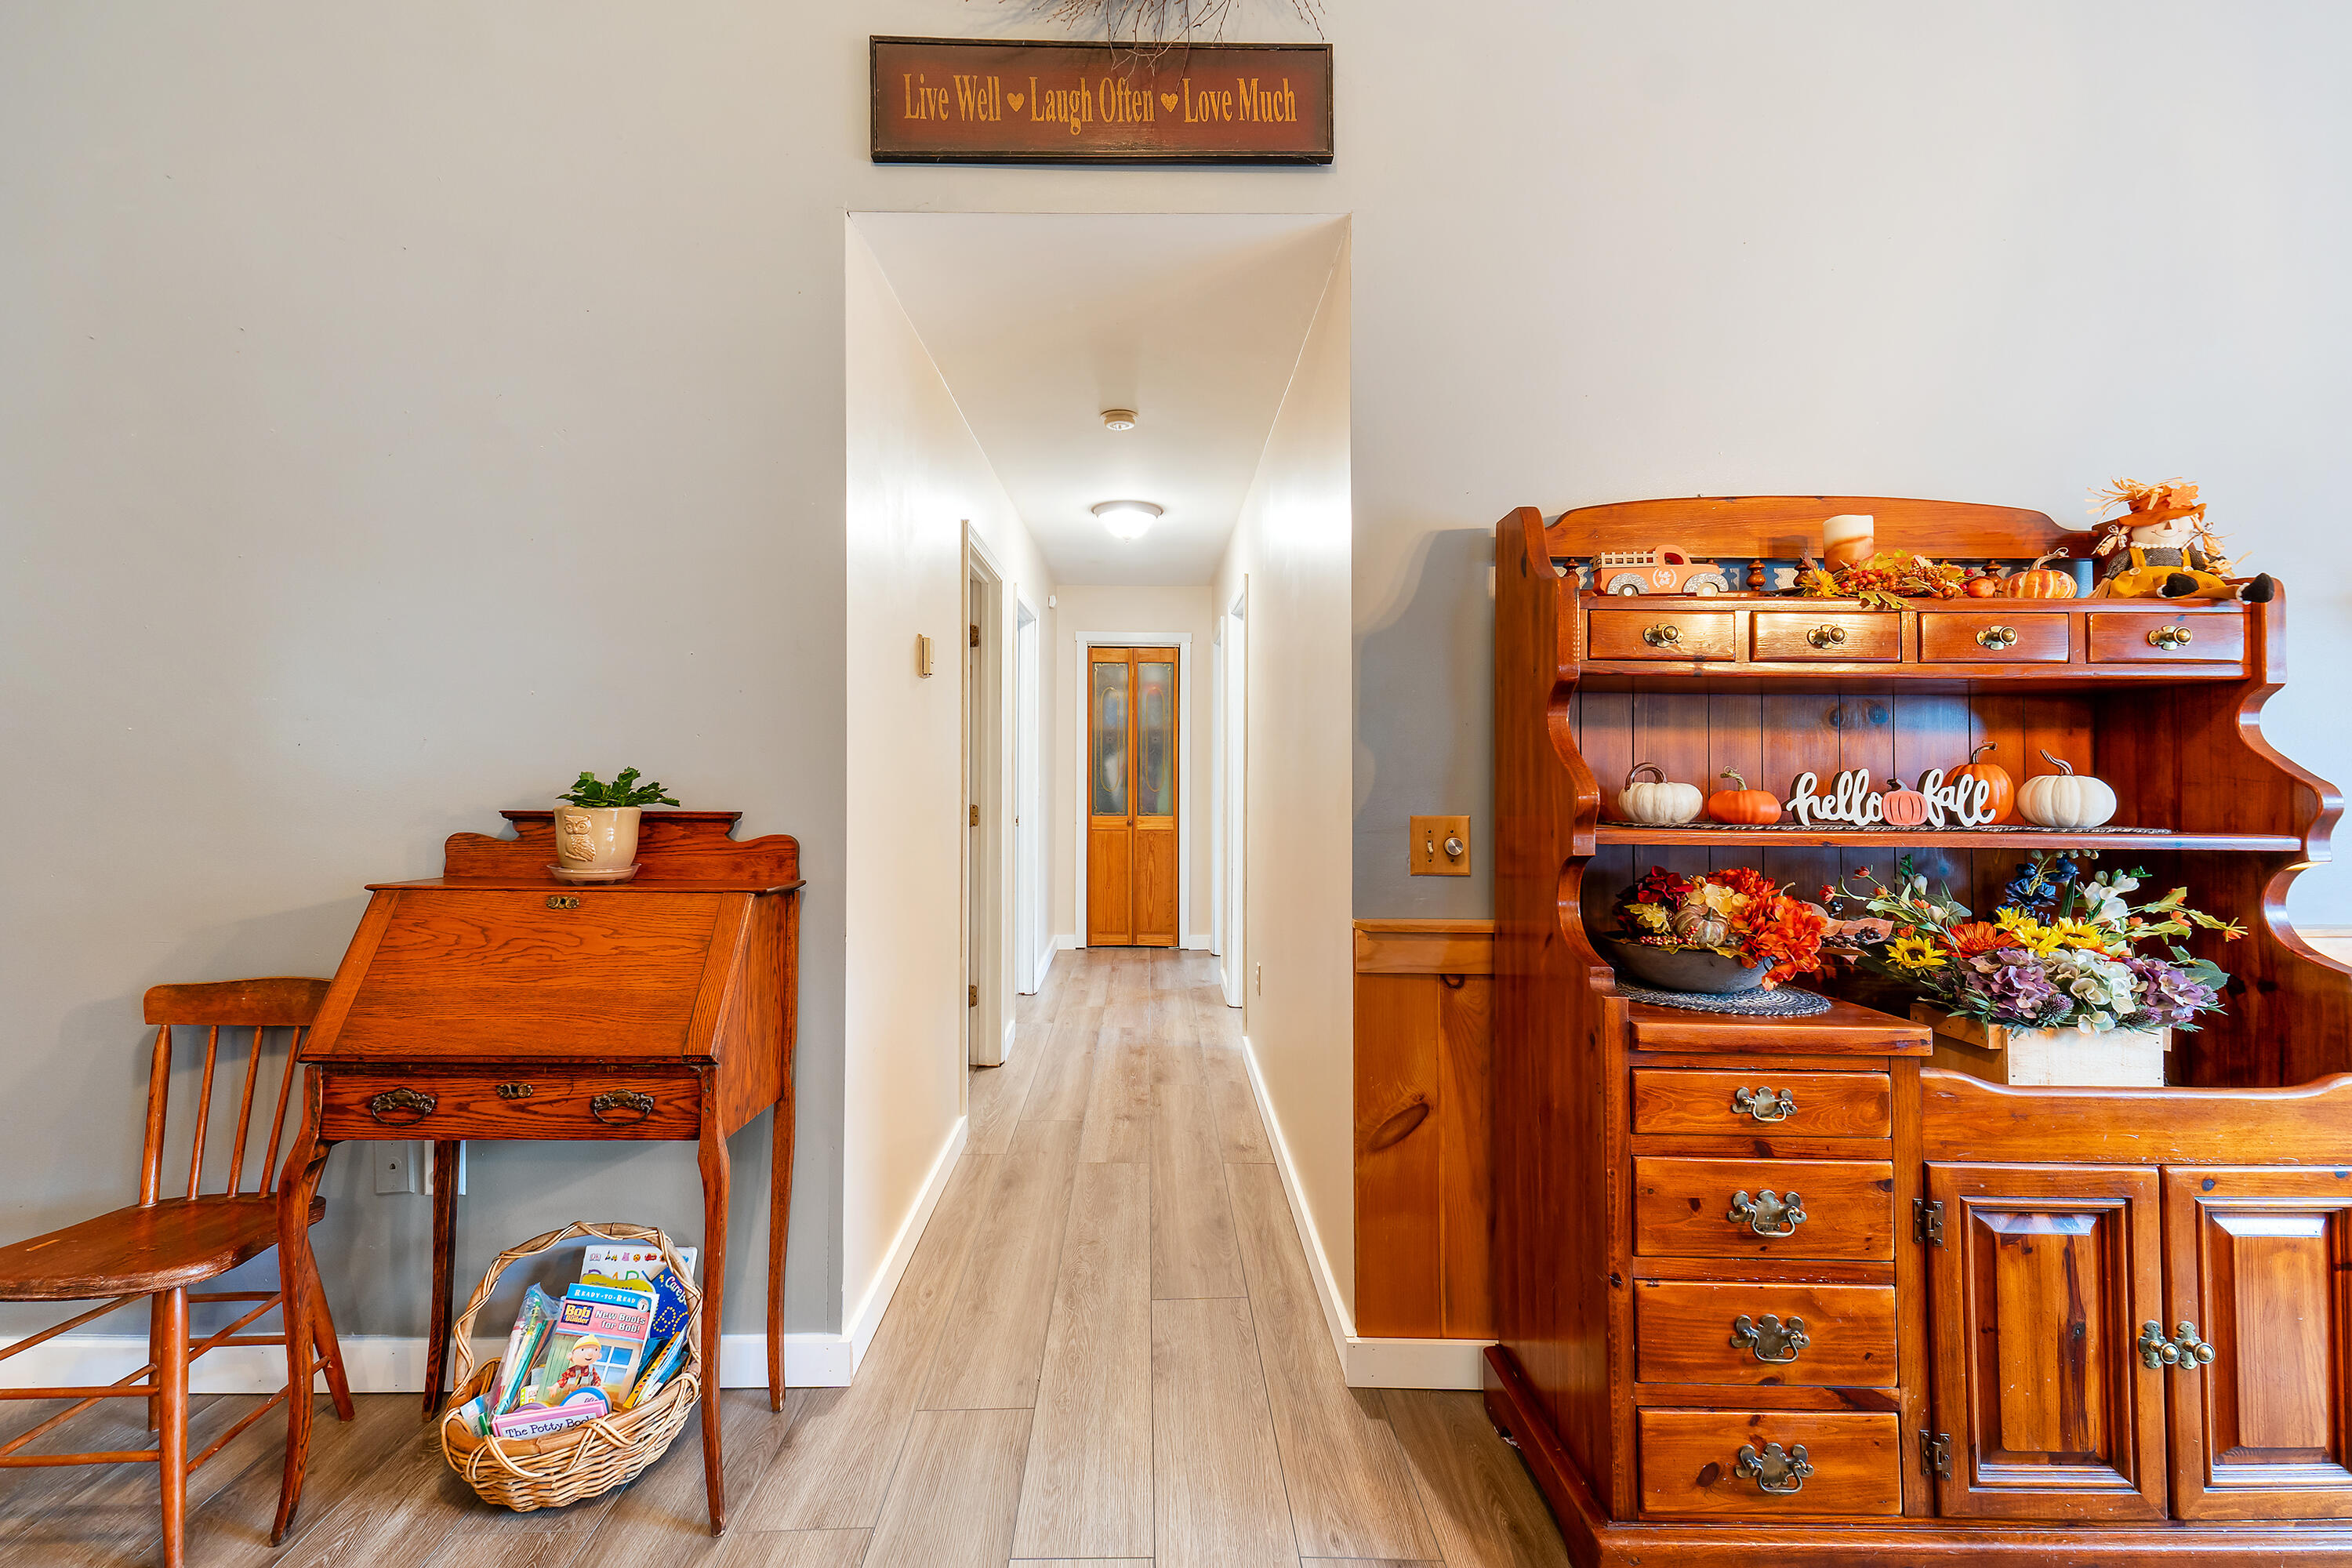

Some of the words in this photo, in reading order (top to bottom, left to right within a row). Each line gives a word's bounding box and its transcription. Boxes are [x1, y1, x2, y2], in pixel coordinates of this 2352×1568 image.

[903, 73, 949, 121] Live
[953, 74, 1002, 122] Well
[1029, 76, 1093, 136] Laugh
[1099, 76, 1156, 123] Often
[1181, 77, 1232, 124] Love
[1238, 77, 1298, 123] Much
[1786, 768, 1883, 826] hello
[1923, 768, 1997, 828] fall
[565, 1304, 591, 1318] Bob
[595, 1310, 617, 1320] New
[618, 1312, 646, 1325] Boots
[564, 1315, 590, 1324] Builder
[601, 1320, 617, 1330] for
[618, 1323, 641, 1334] Bob!
[505, 1428, 528, 1438] The
[529, 1421, 564, 1435] Potty
